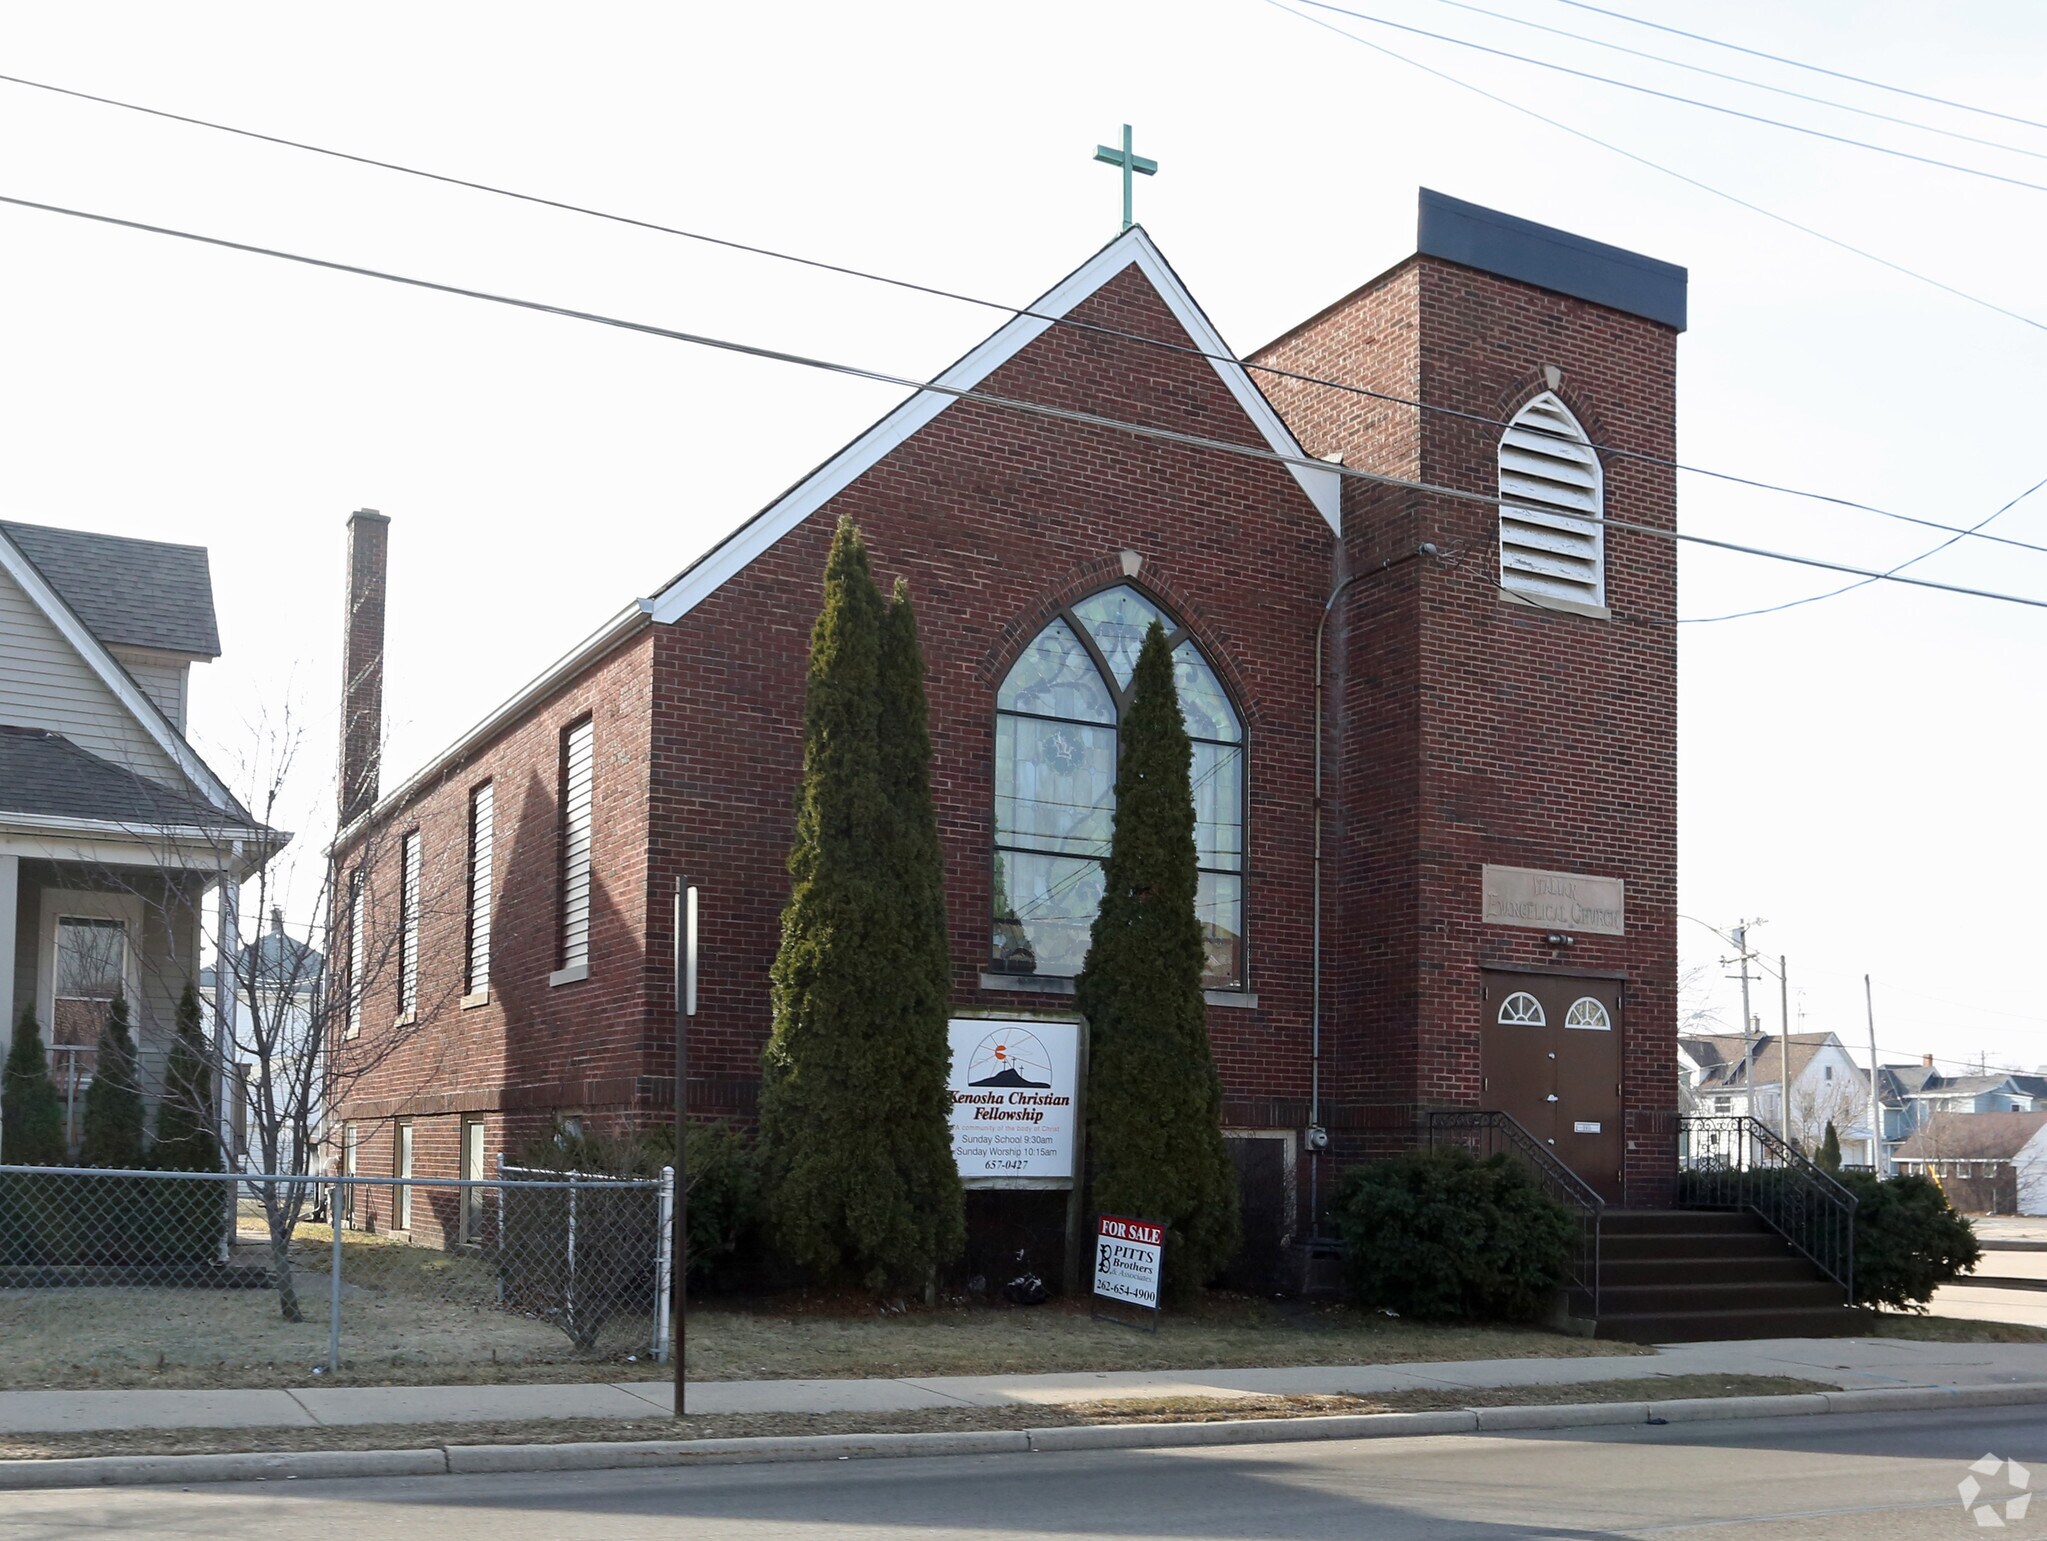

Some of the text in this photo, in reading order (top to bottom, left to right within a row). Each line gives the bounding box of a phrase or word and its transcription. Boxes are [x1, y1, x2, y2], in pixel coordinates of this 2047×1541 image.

[1008, 1091, 1070, 1106] Christian
[973, 1107, 1044, 1124] Fellowship
[962, 1134, 1053, 1145] Sunday School 9:30am
[956, 1147, 1057, 1157] Sunday Worship 10:15am
[985, 1160, 1028, 1170] 657-0427
[1102, 1219, 1160, 1244] FOR SALE
[1114, 1245, 1154, 1264] PITTS
[1112, 1257, 1153, 1275] Brothers
[1096, 1279, 1156, 1302] 262-654-4900
